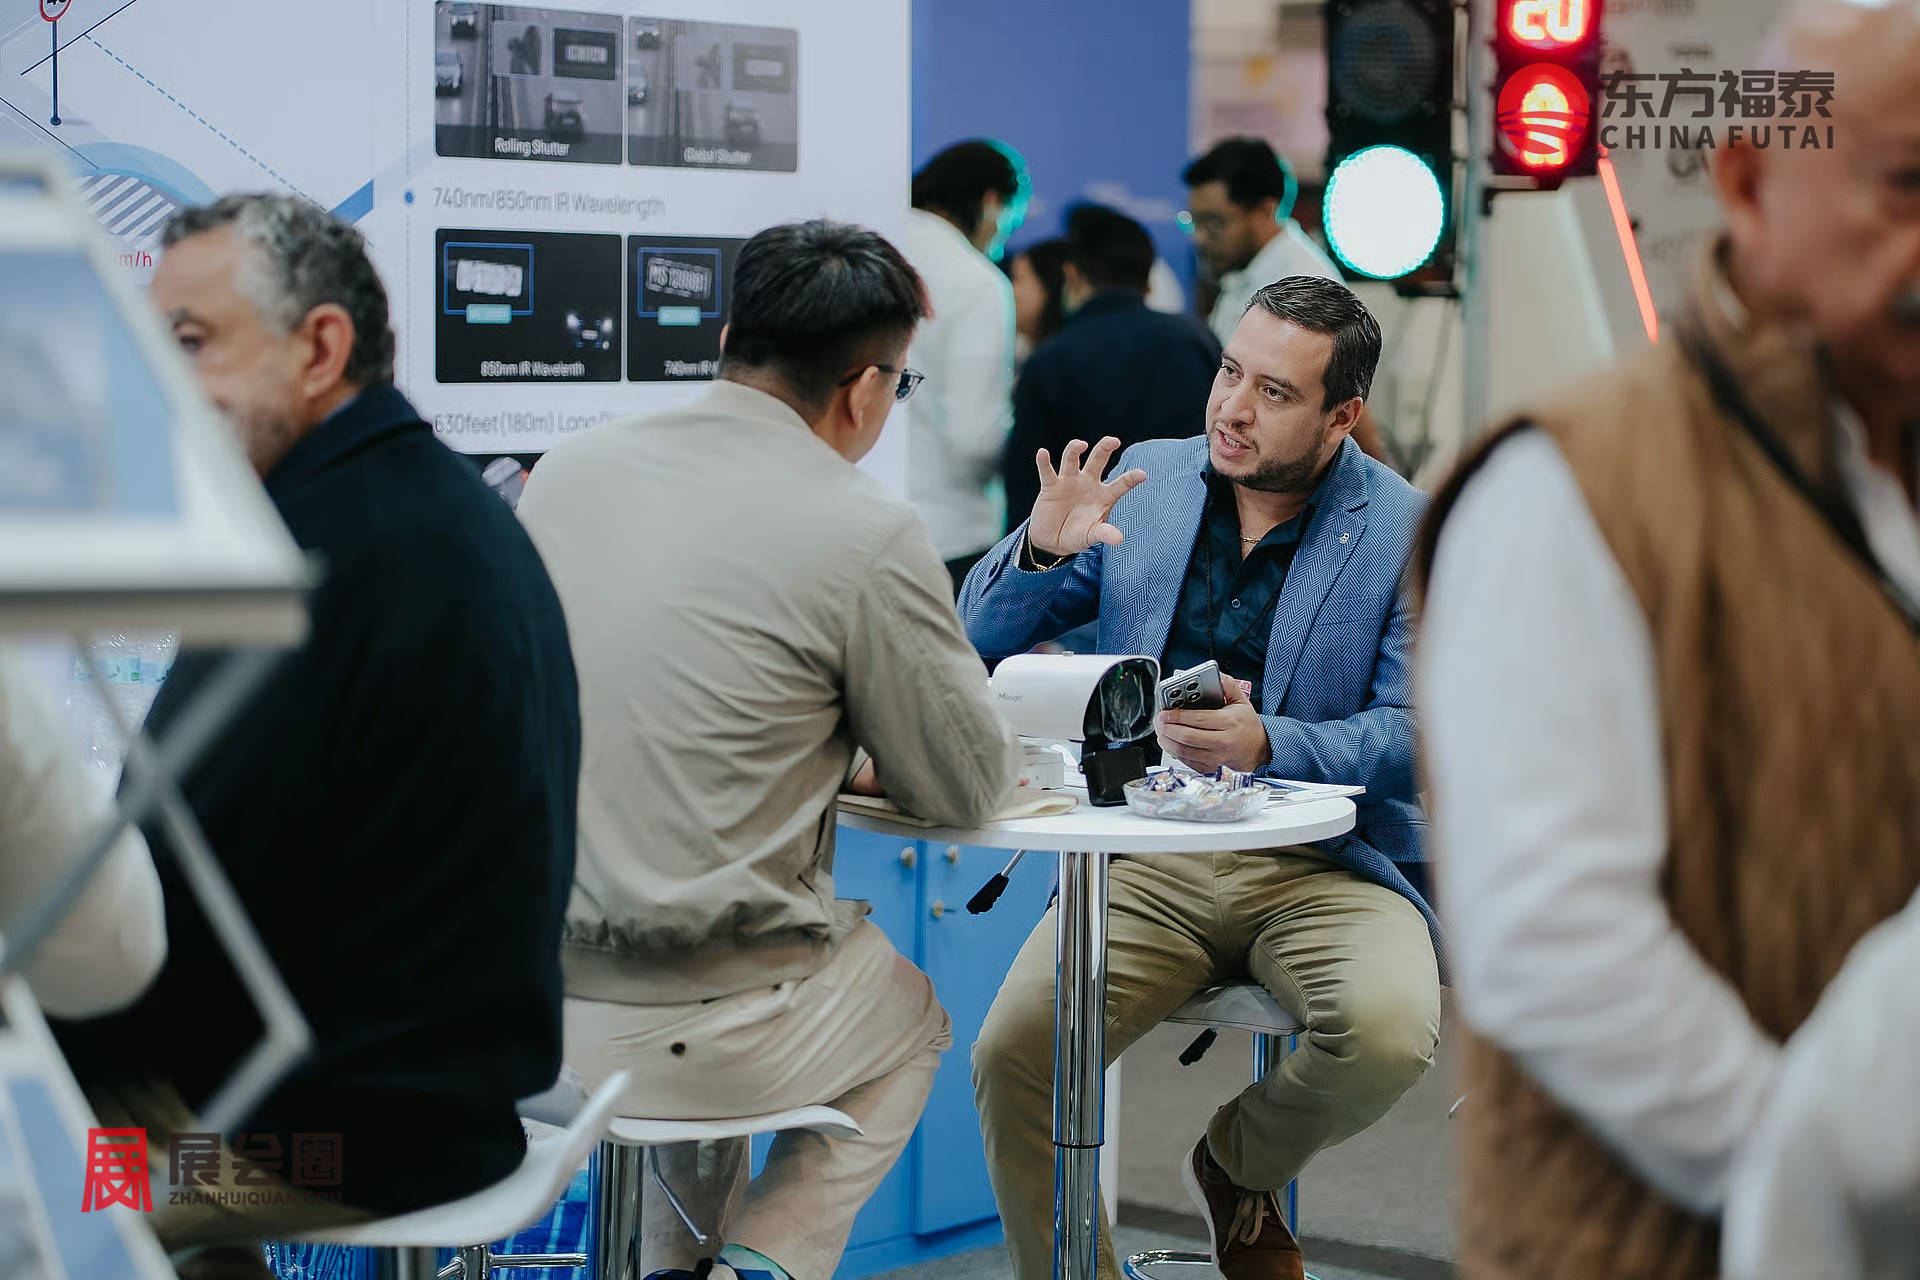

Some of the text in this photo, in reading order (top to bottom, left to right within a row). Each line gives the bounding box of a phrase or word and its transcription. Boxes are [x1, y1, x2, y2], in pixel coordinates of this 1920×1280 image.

[494, 137, 570, 157] Rolling Shutter
[553, 191, 570, 212] IR
